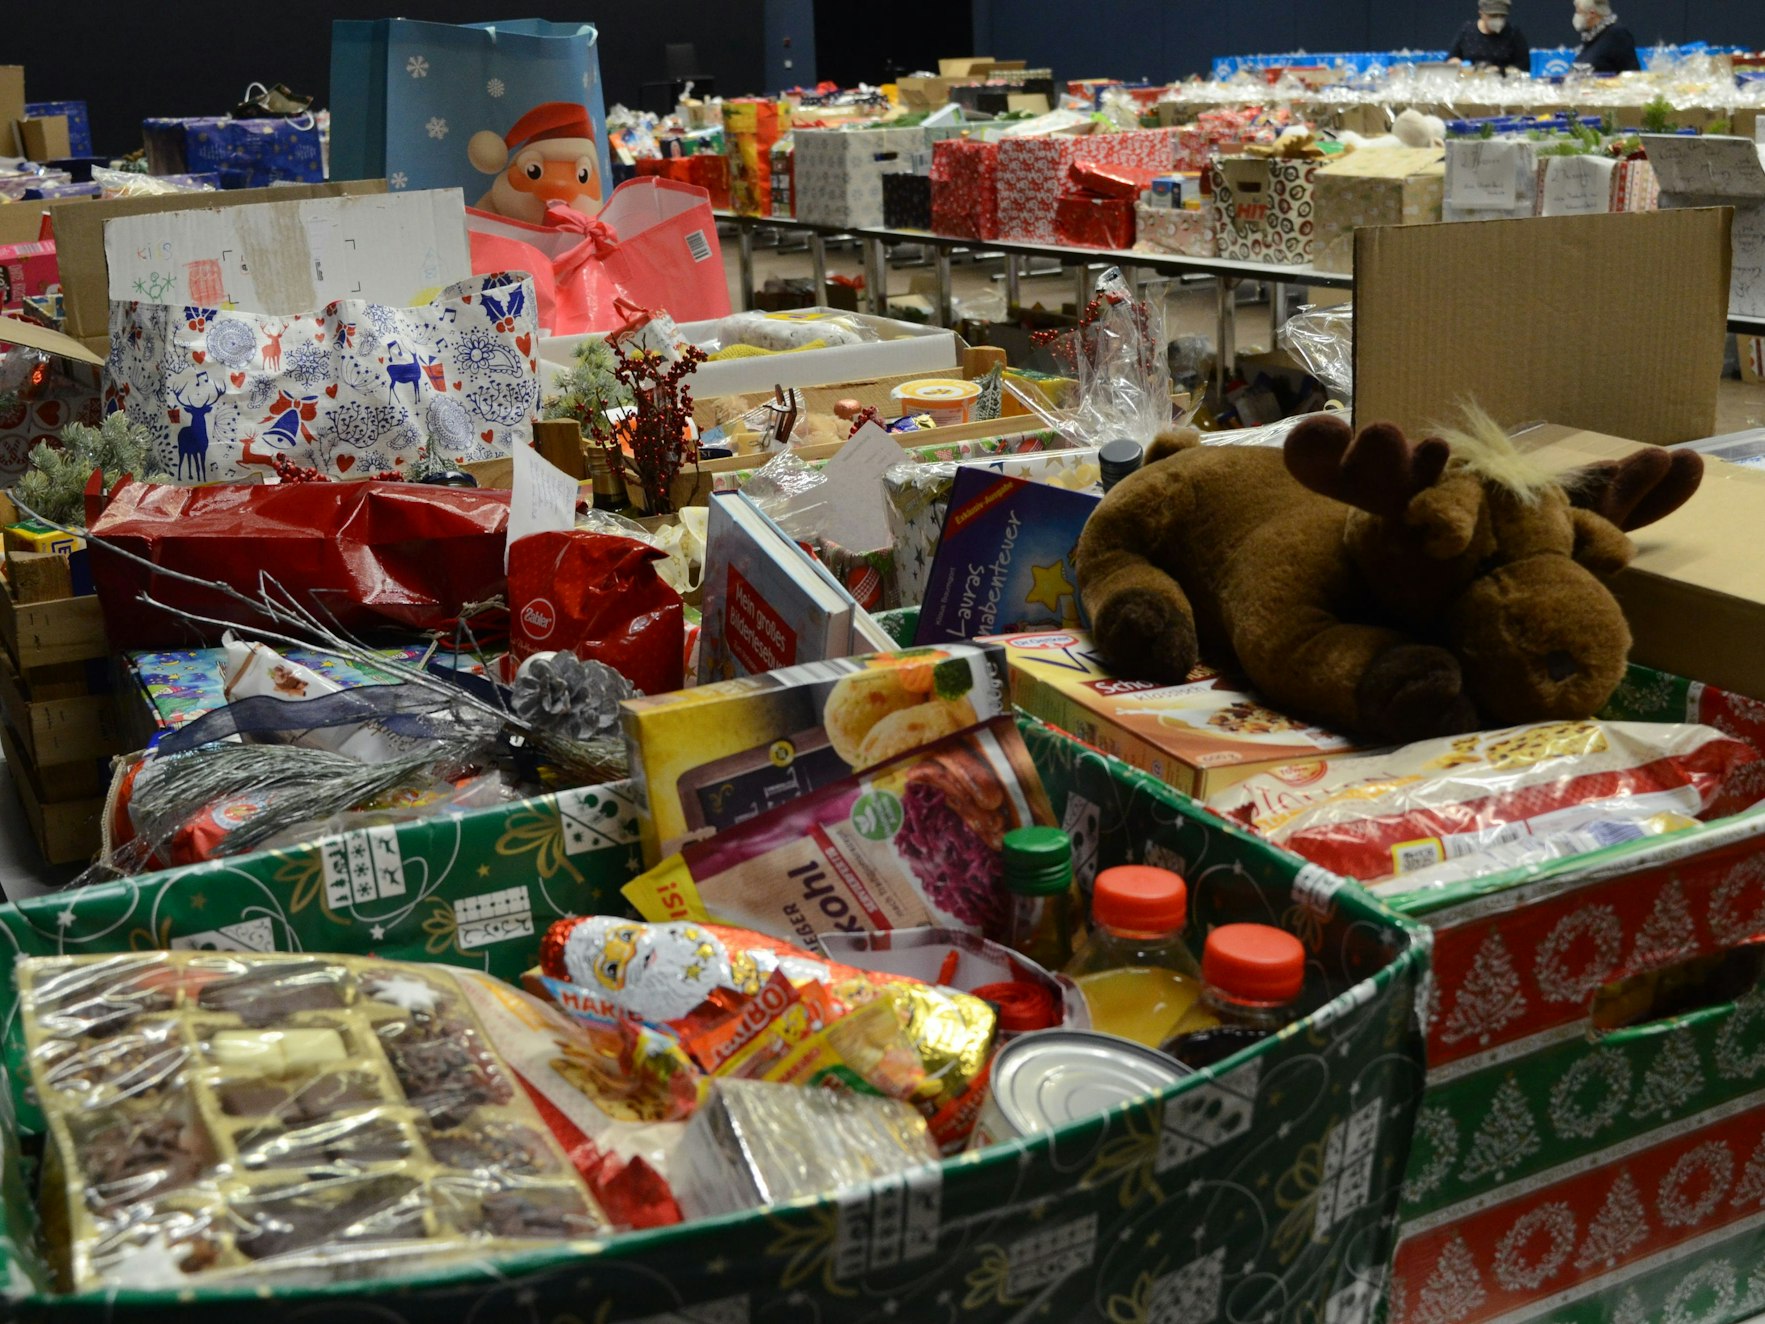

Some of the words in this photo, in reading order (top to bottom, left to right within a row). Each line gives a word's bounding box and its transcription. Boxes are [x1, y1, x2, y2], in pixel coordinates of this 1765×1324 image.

[1236, 203, 1269, 220] HIT
[736, 582, 755, 619] Mein
[946, 563, 985, 638] Lauras
